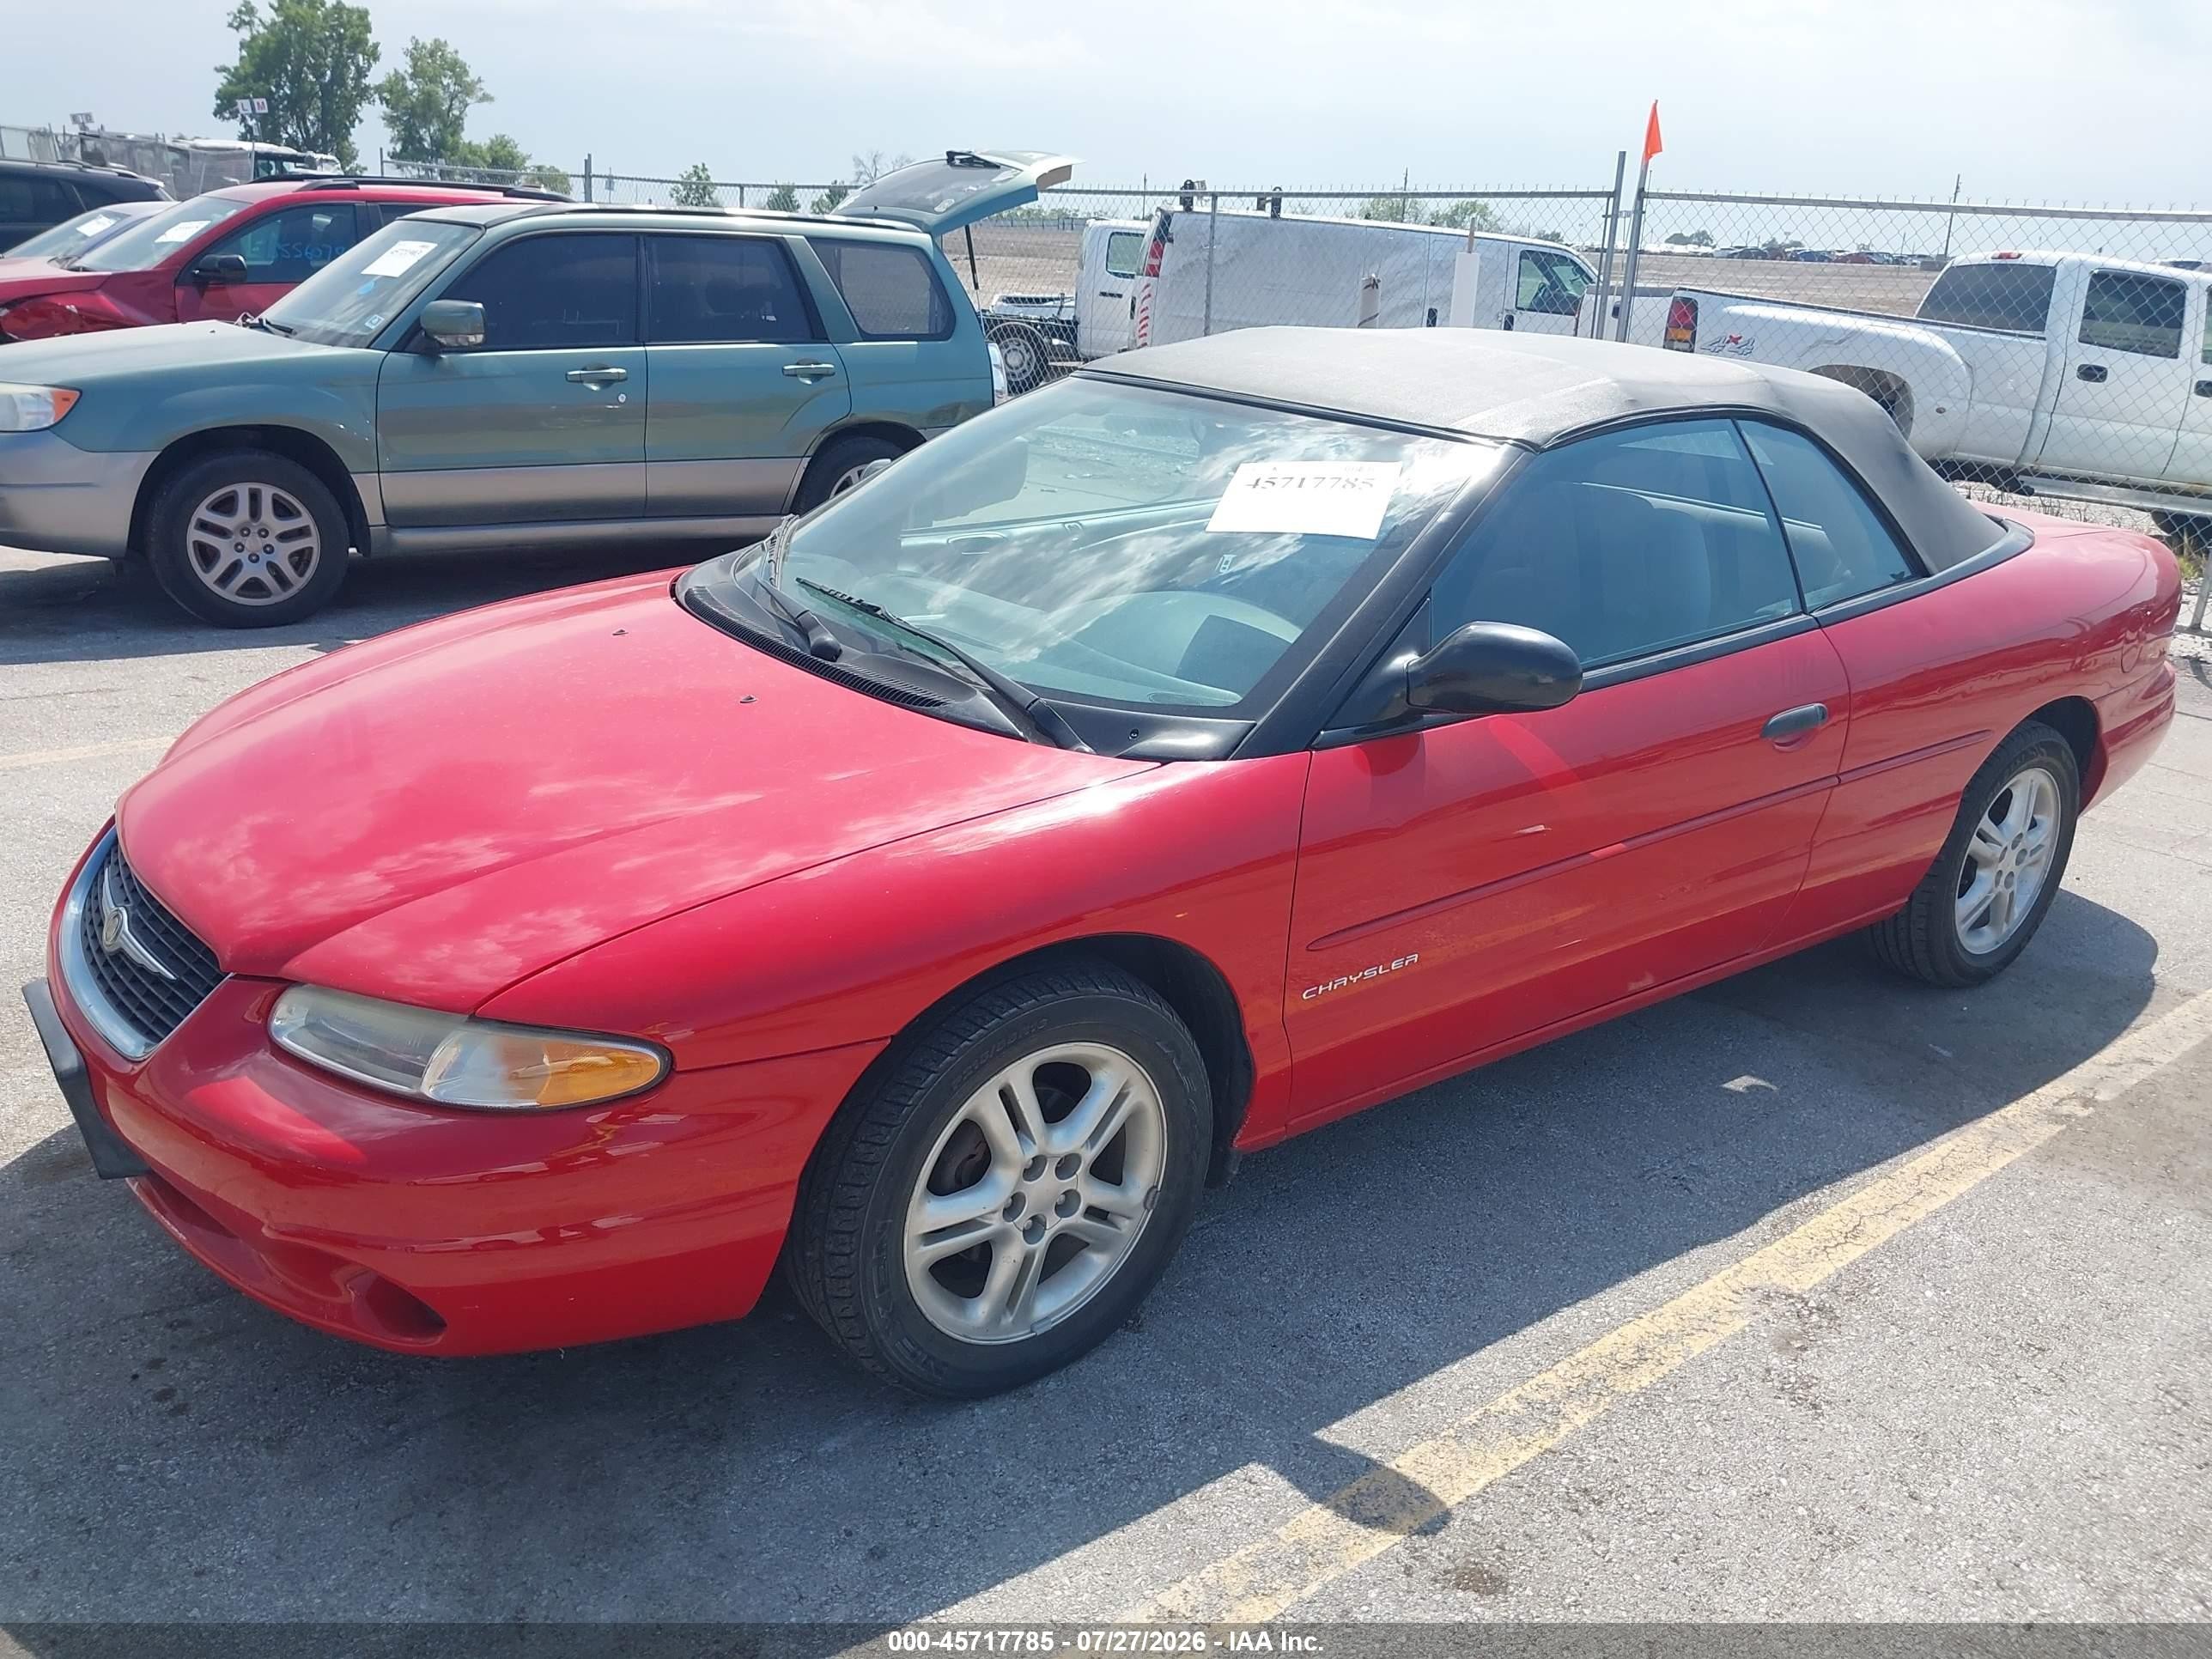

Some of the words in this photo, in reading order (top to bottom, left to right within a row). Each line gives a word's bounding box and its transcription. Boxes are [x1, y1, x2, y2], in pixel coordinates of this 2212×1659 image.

[257, 101, 266, 111] M
[1245, 477, 1374, 489] 45717785
[1302, 953, 1419, 1000] CHRYSLER
